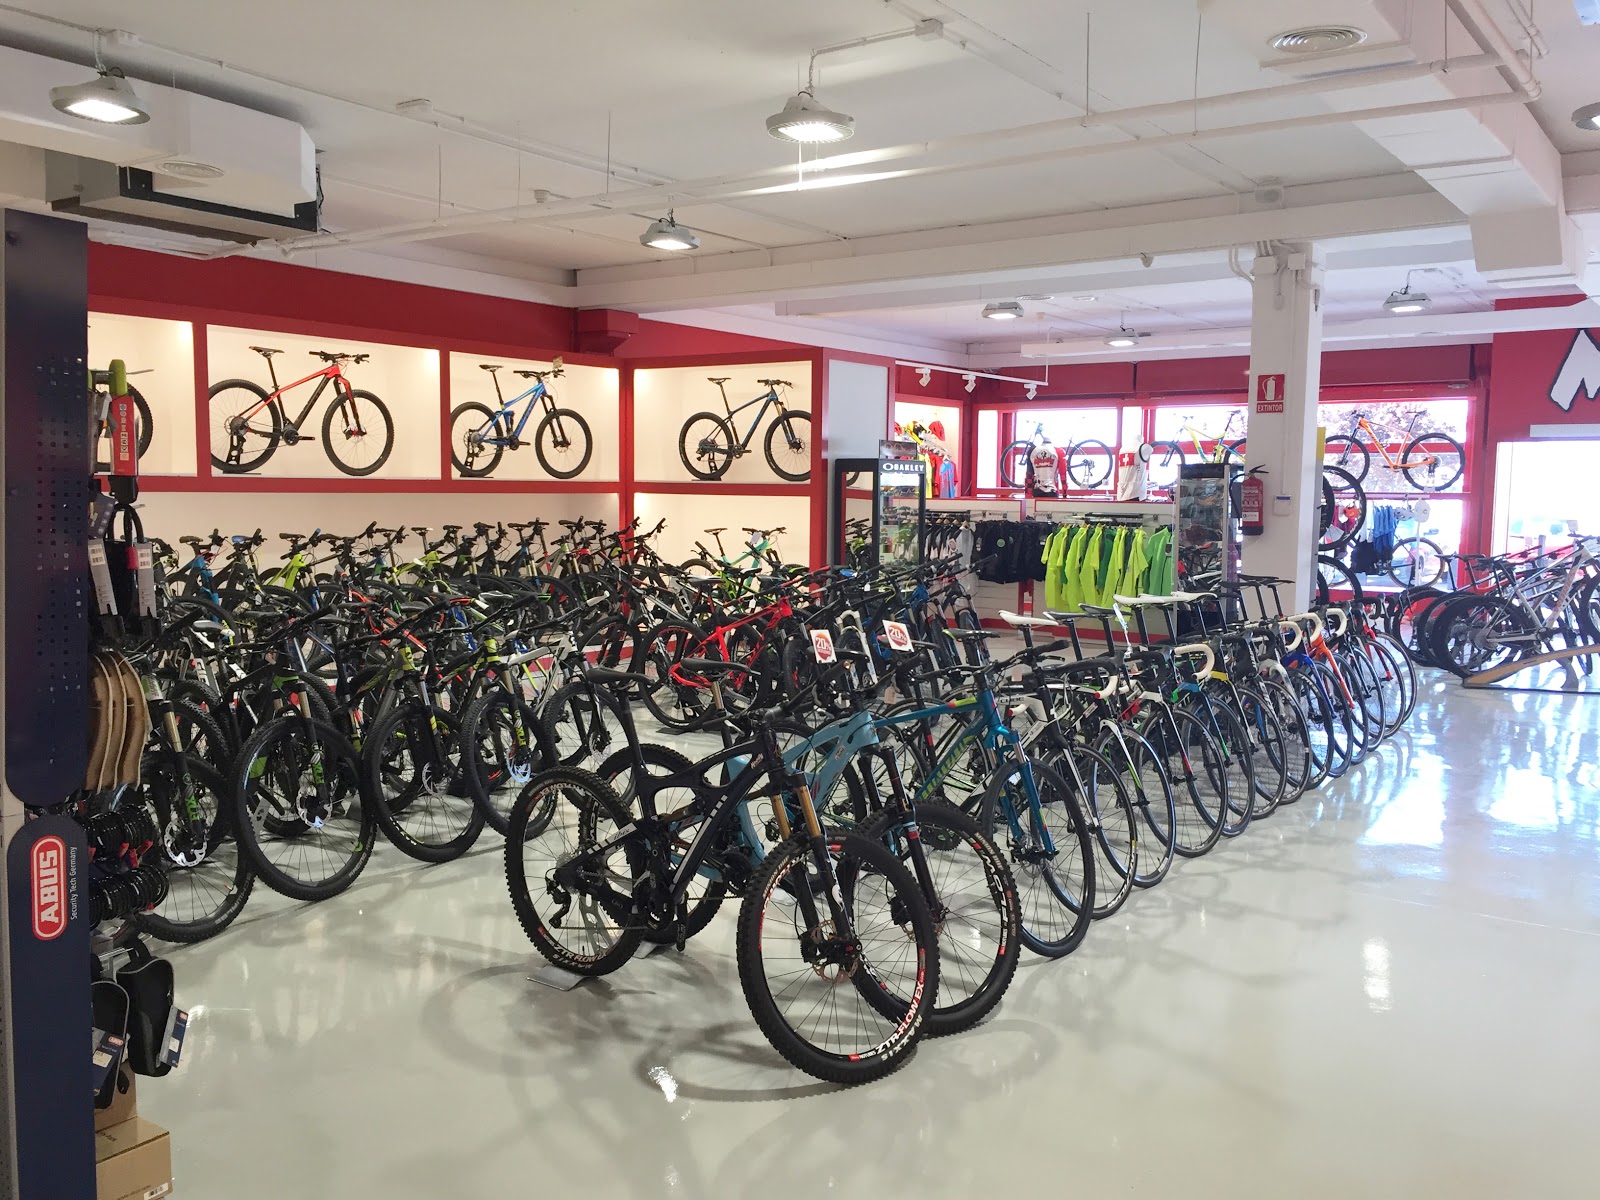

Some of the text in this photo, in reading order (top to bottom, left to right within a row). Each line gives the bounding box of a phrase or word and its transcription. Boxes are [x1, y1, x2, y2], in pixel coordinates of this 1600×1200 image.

[1257, 404, 1283, 412] EXTINTOR
[69, 847, 77, 876] Germany
[39, 850, 58, 923] ABUS
[70, 893, 78, 920] Security
